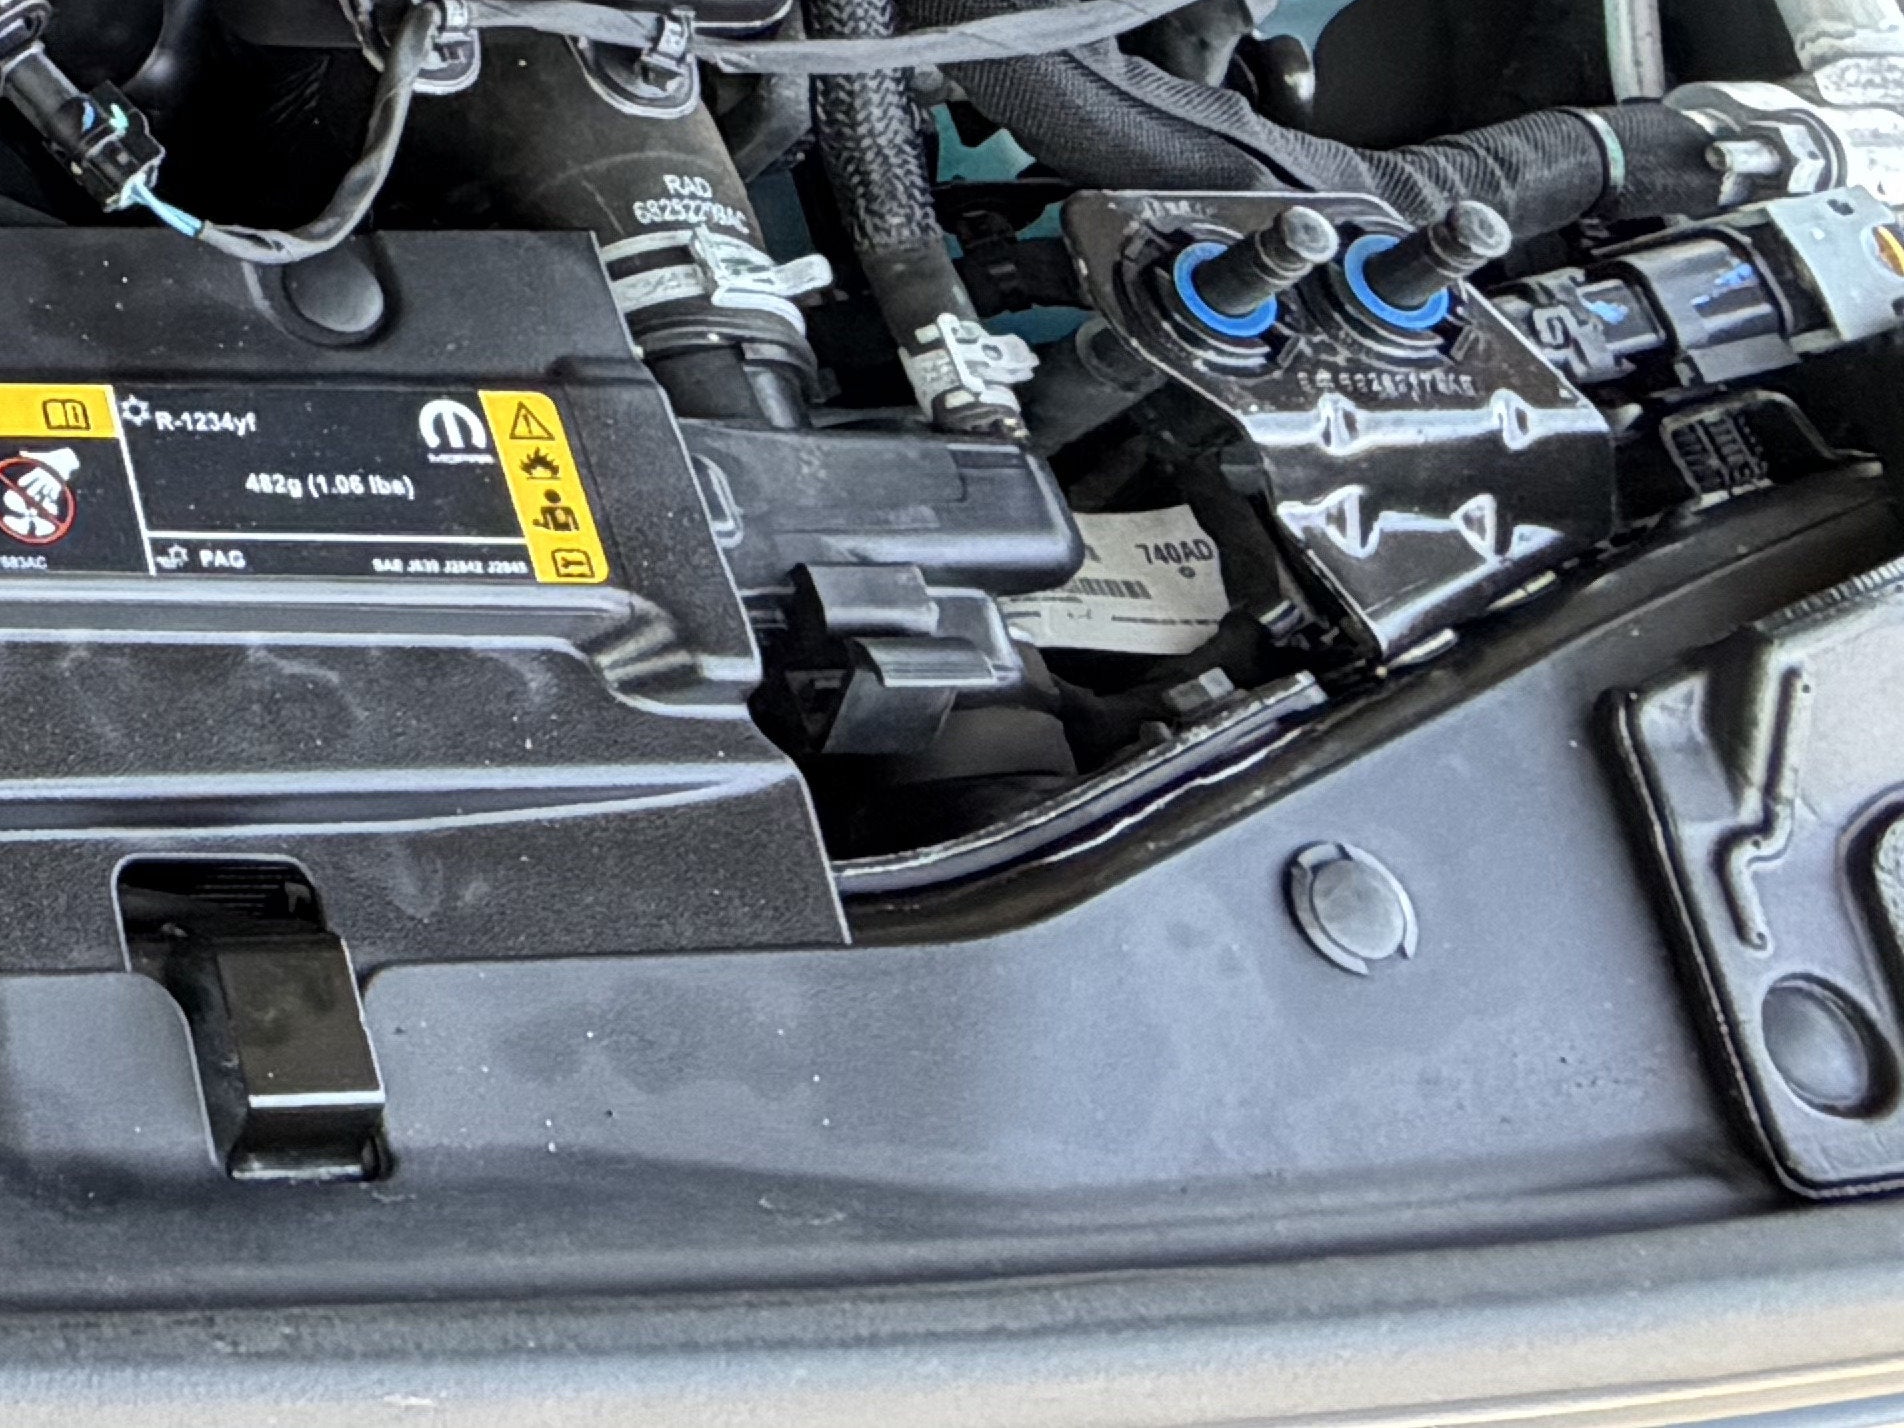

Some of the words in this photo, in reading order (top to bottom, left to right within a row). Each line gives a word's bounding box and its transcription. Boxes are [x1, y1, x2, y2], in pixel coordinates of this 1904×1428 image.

[662, 174, 712, 198] RAD
[154, 410, 257, 437] R-1234yf
[245, 472, 303, 499] 482g
[199, 548, 246, 570] PAG
